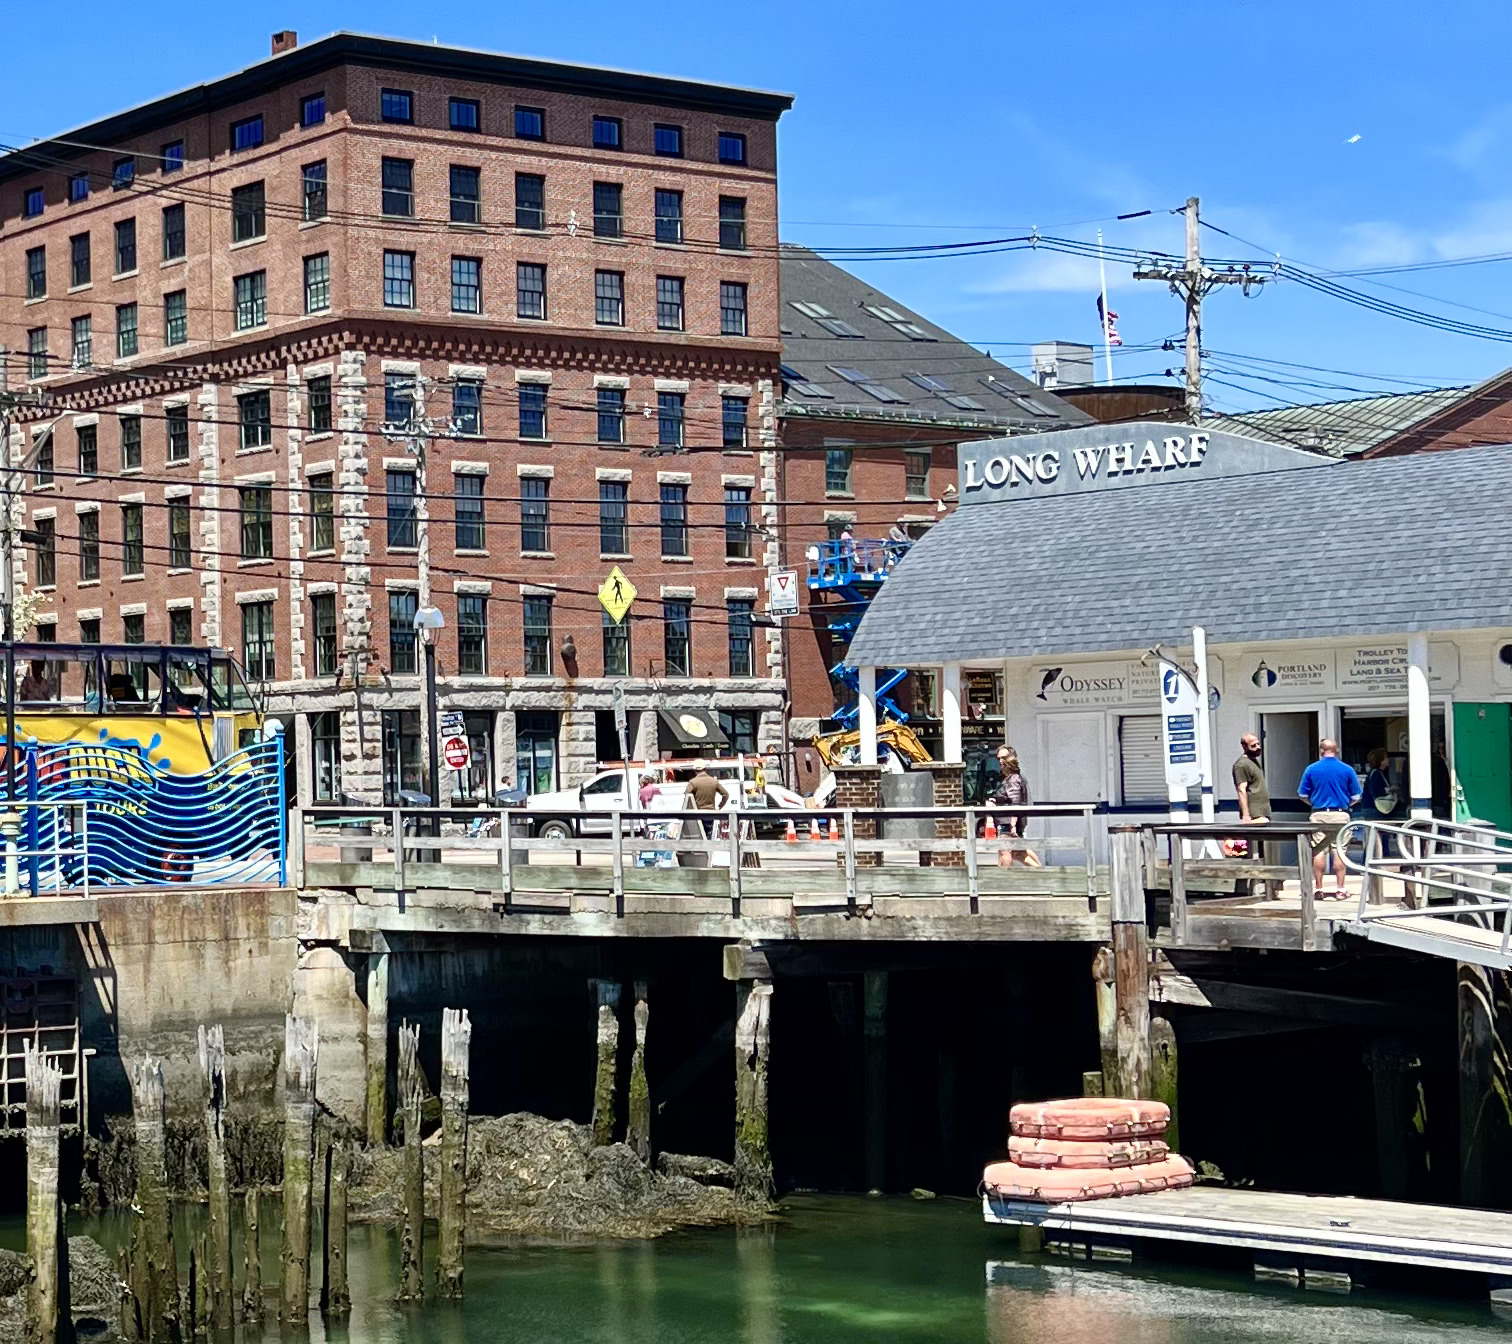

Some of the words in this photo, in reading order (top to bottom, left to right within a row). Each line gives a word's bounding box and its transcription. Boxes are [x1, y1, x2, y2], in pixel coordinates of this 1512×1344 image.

[964, 451, 1061, 490] LONG
[1073, 433, 1210, 480] WHARF
[1357, 649, 1394, 657] TROLLEY
[1278, 664, 1326, 673] PORTLAND
[1354, 658, 1389, 666] HARBOR
[1061, 675, 1126, 692] ODYSSEY
[1166, 674, 1179, 698] 1
